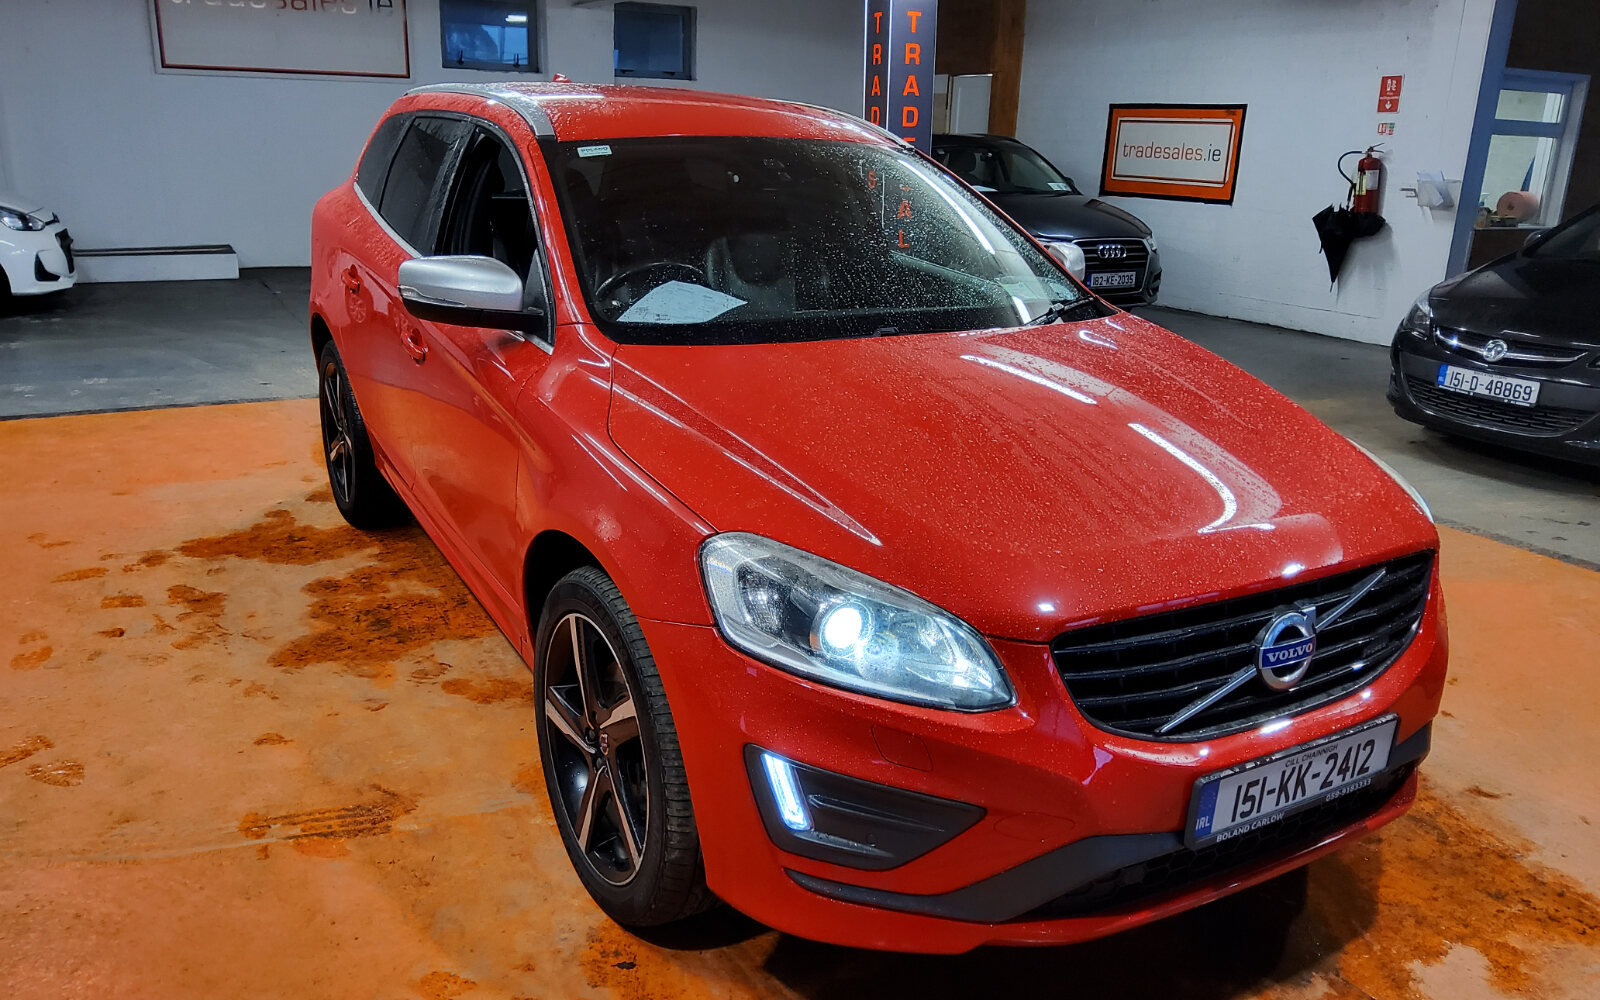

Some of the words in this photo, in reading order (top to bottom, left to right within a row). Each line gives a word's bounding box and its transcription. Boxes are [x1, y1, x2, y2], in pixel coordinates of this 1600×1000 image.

[901, 11, 922, 143] TRAD
[1122, 141, 1222, 162] tradesales.ie
[1092, 274, 1134, 286] 182-KE-2035
[1450, 370, 1533, 401] 151-D-48869
[1266, 642, 1313, 663] VOLVO
[1195, 815, 1211, 830] IRL
[1230, 738, 1375, 823] 151-KK-2412
[1216, 823, 1250, 842] BOLAND
[1251, 811, 1285, 831] CARLOW
